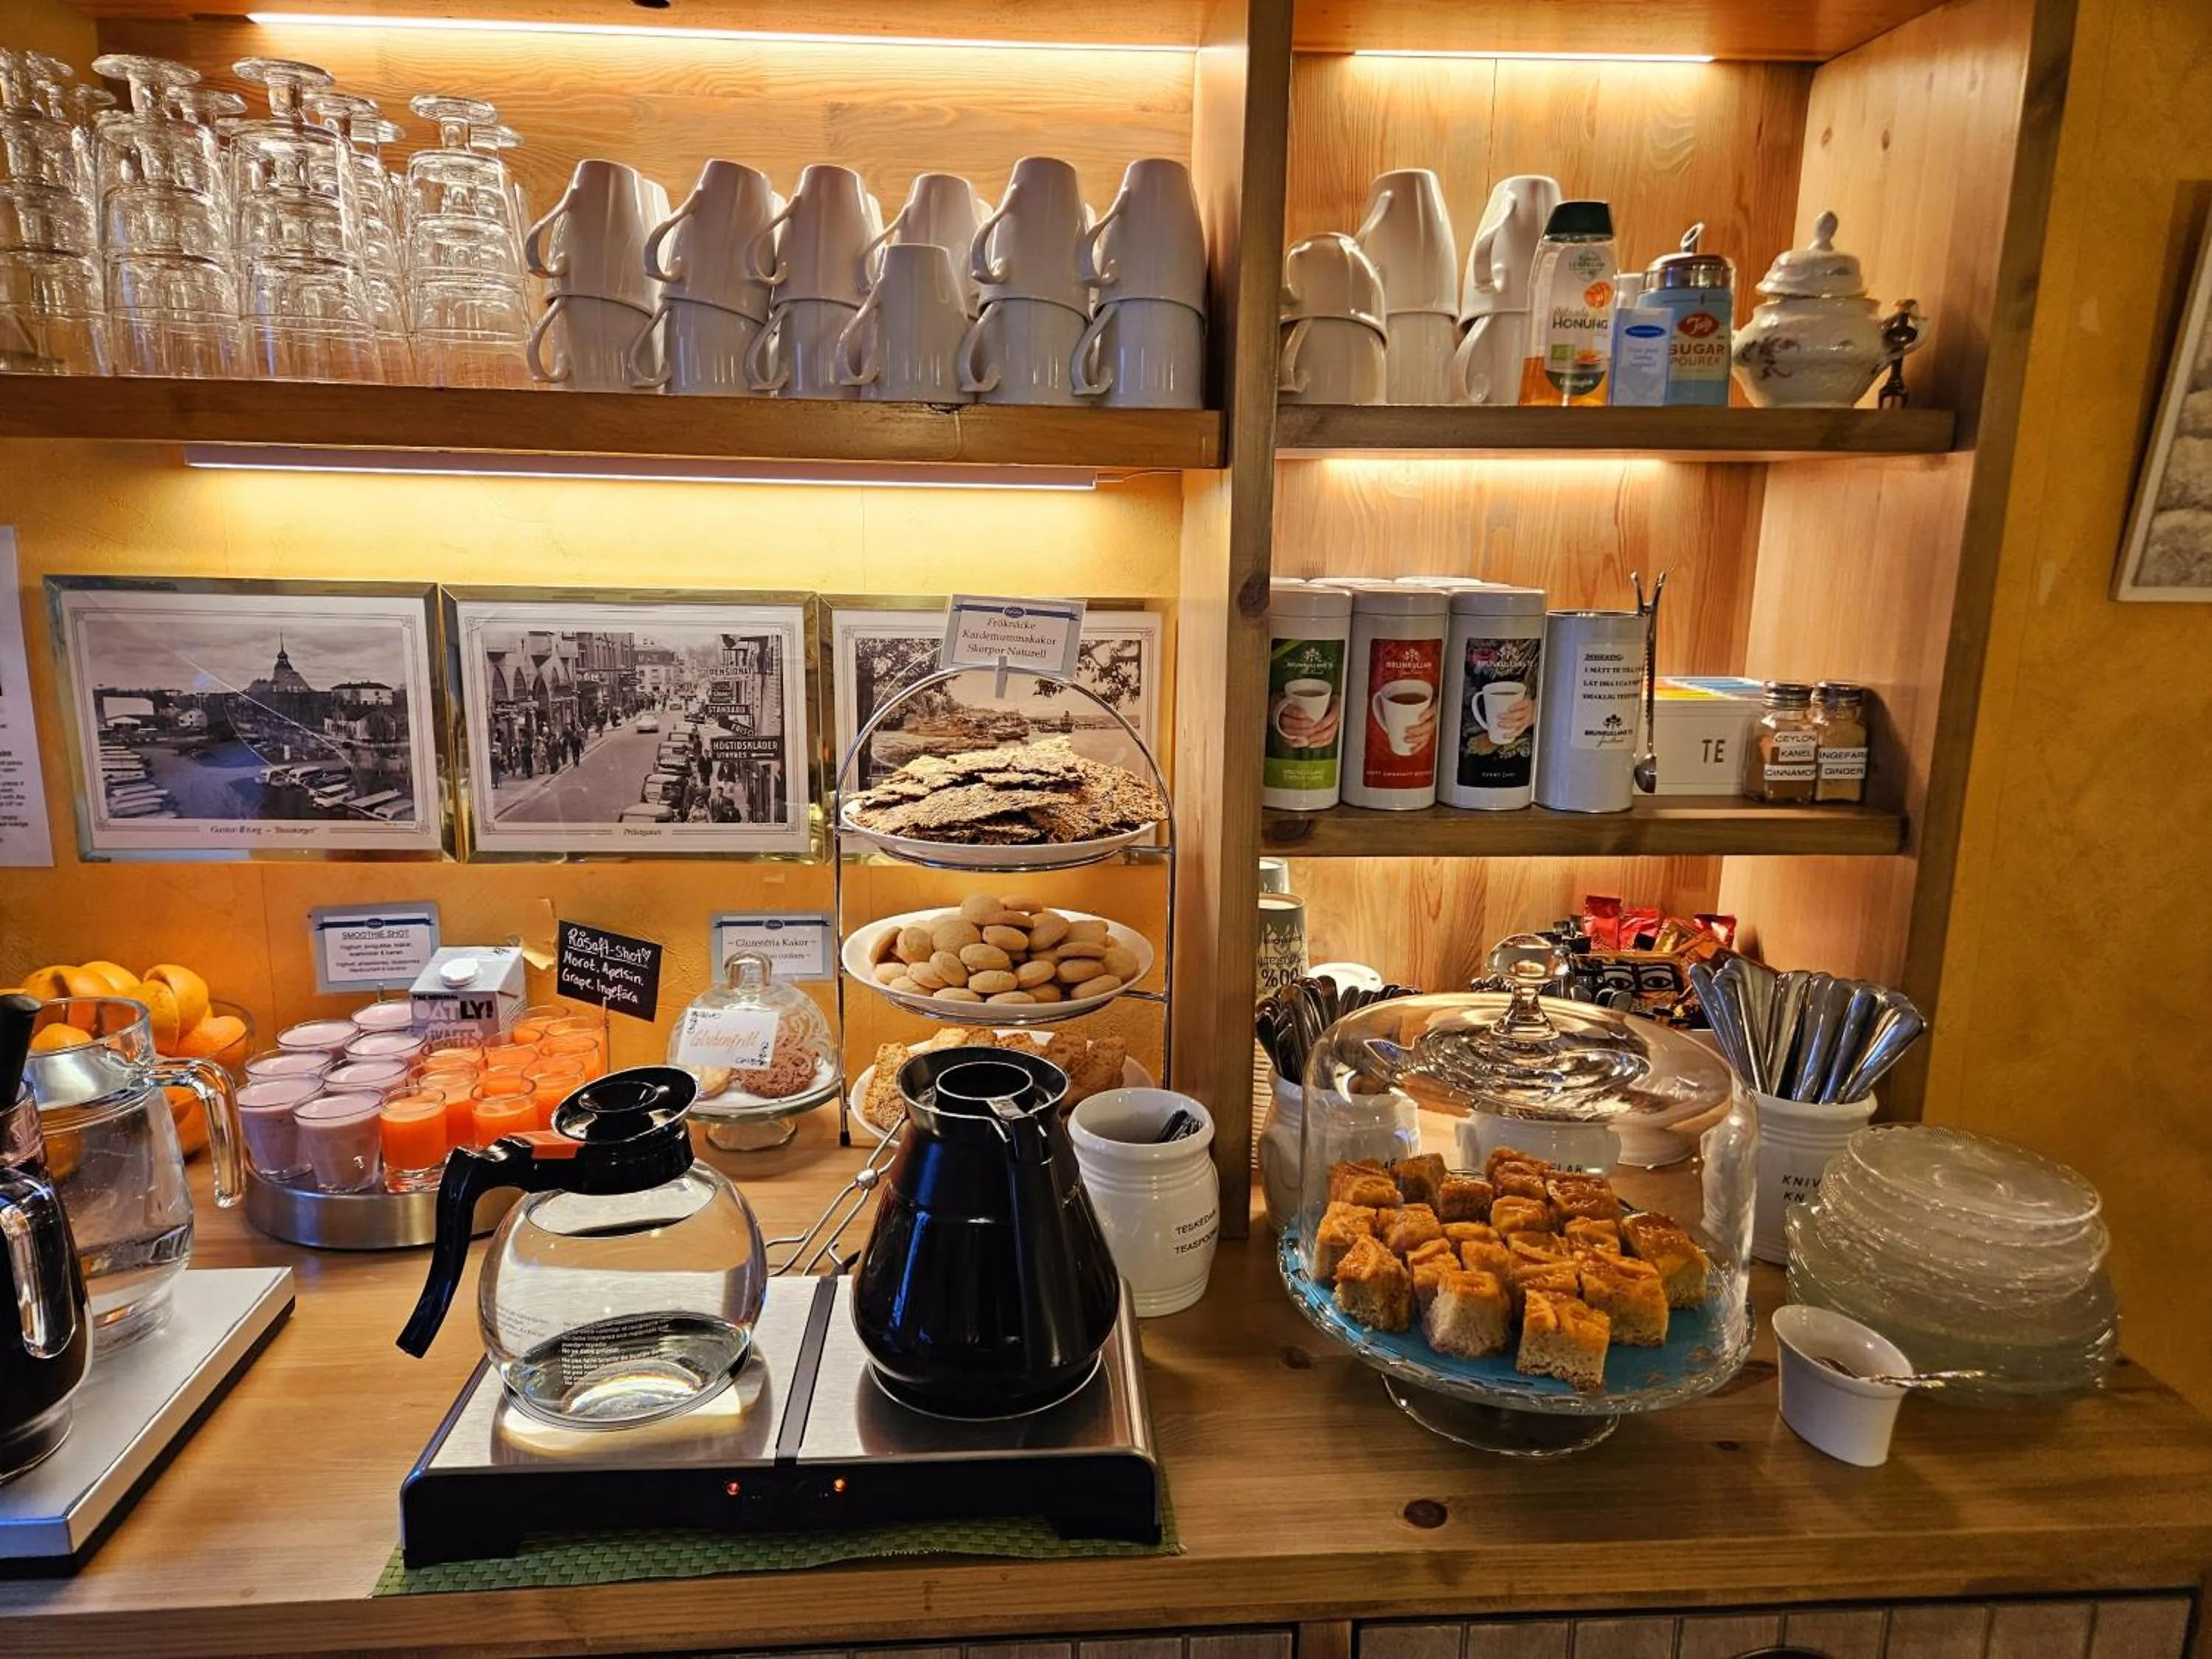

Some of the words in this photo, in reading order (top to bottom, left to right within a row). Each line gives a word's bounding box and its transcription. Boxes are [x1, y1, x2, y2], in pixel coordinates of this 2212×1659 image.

[1552, 317, 1608, 330] HONUNG
[1669, 344, 1725, 355] SUGAR
[967, 644, 1004, 655] Skorpor
[1702, 740, 1725, 763] TE
[341, 931, 384, 940] SMOOTHIE
[387, 929, 410, 938] SHOT
[782, 938, 808, 946] Kakor
[413, 1000, 493, 1020] OATLY!
